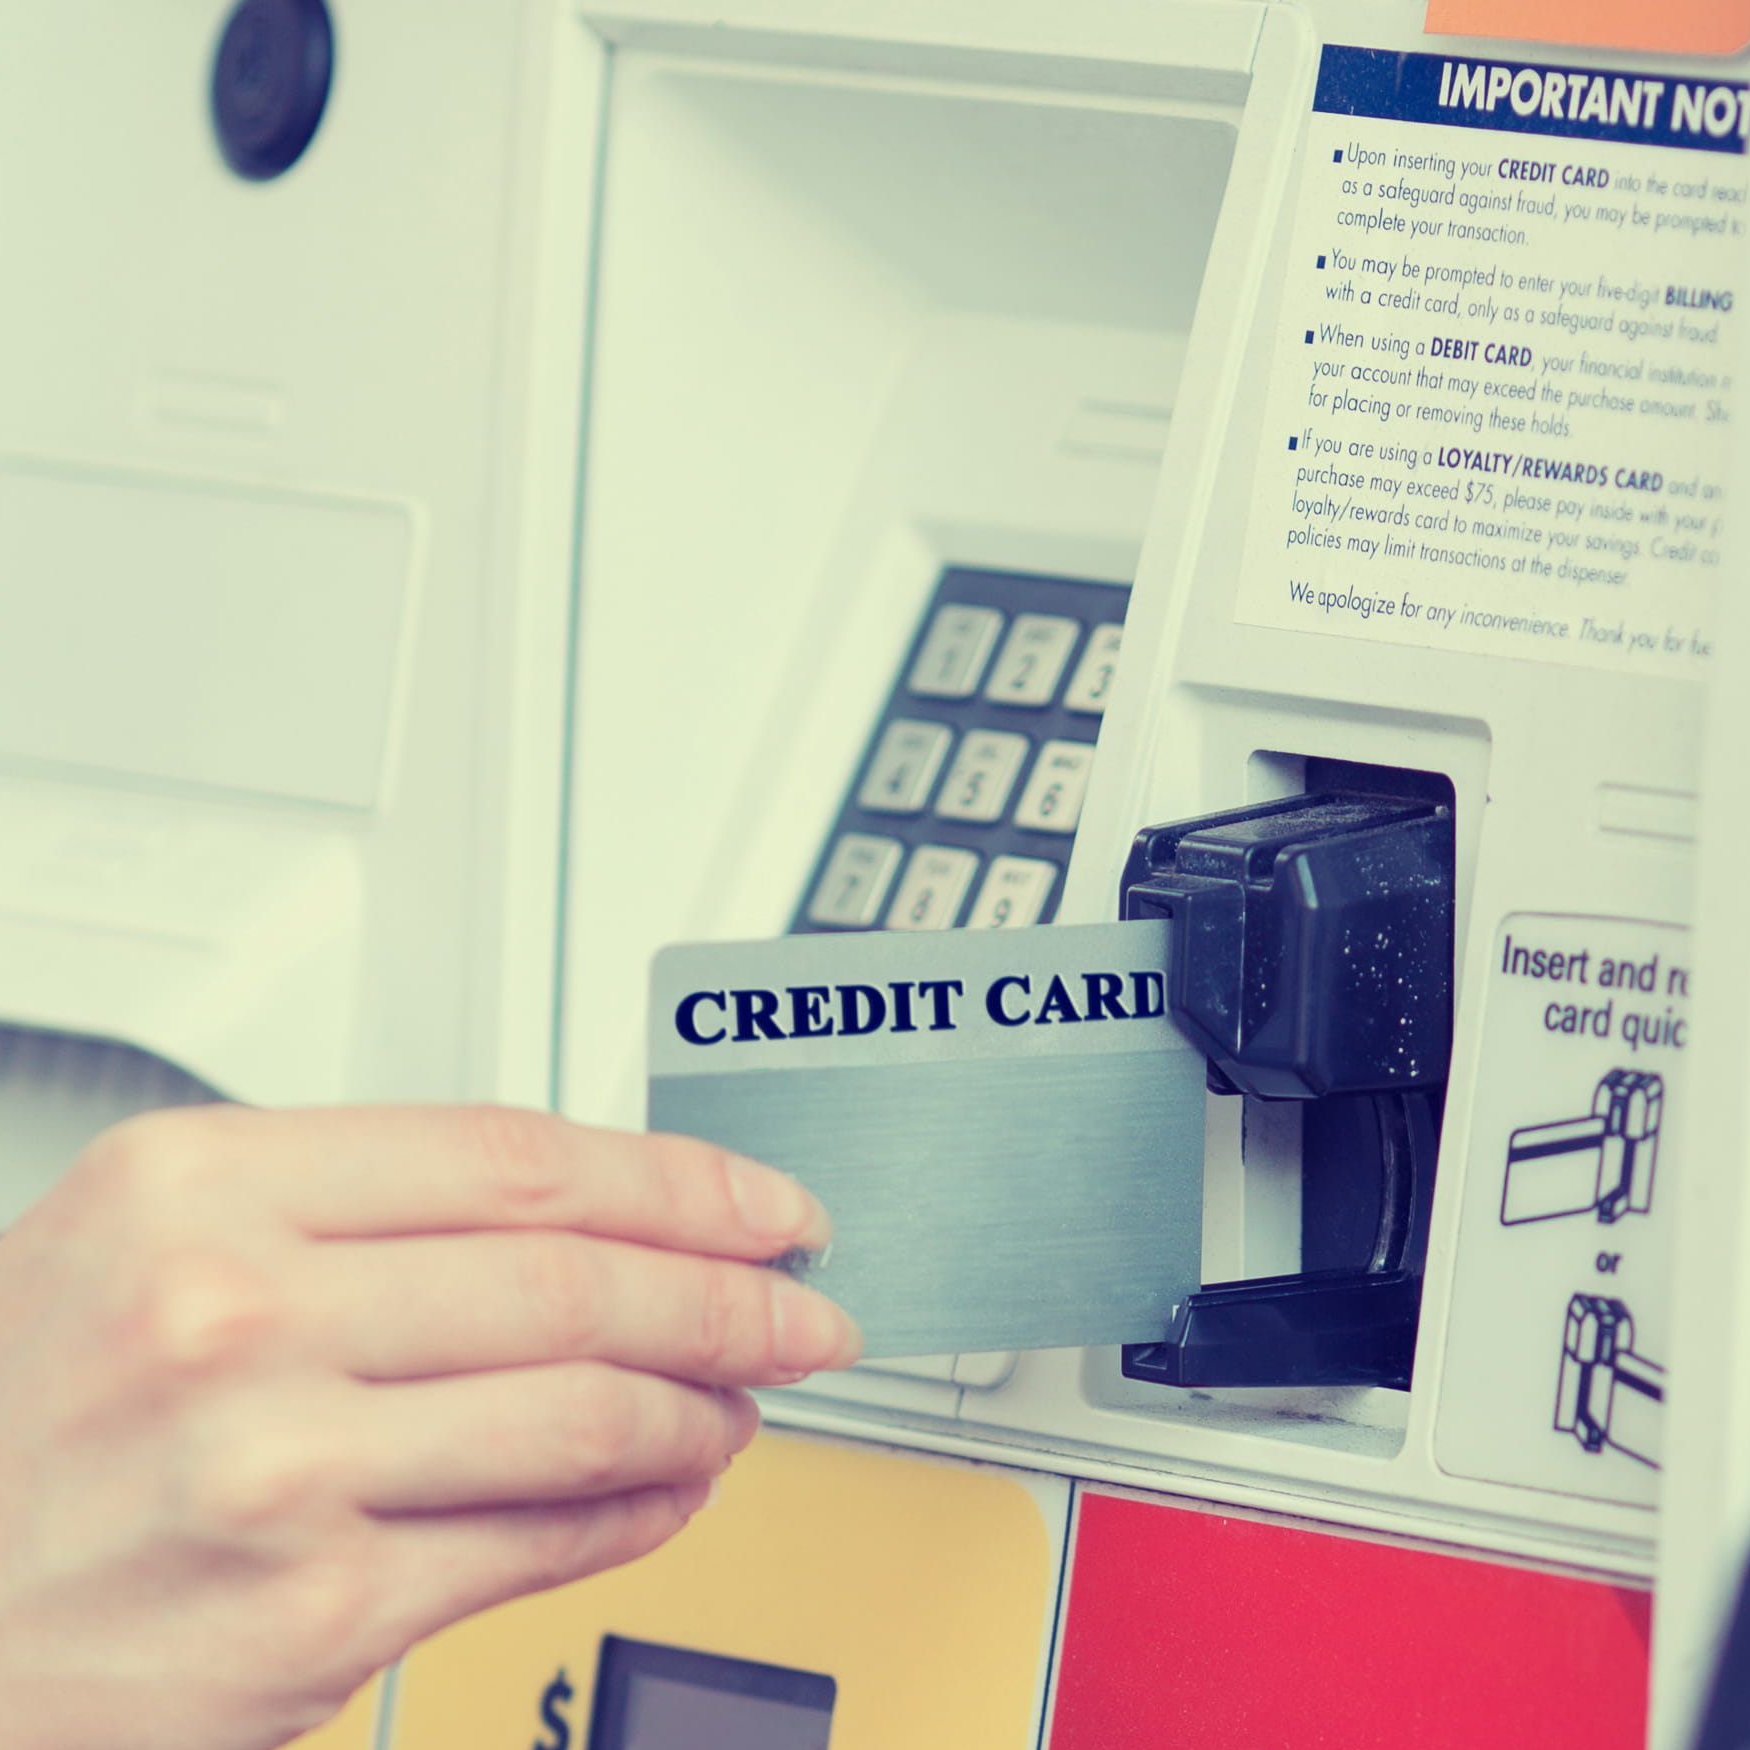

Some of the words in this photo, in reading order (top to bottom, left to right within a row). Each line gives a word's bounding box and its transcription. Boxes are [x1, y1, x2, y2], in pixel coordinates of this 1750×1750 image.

[1438, 61, 1664, 130] IMPORTANT
[1346, 140, 1387, 170] Upon
[1392, 147, 1456, 180] inserting
[1459, 160, 1493, 181] your
[1497, 157, 1557, 183] CREDIT
[1560, 163, 1610, 189] CARD
[1336, 207, 1406, 235] complete
[1409, 219, 1444, 240] your
[1446, 219, 1528, 245] transaction.
[1340, 179, 1358, 195] as
[1361, 181, 1373, 197] a
[1377, 176, 1456, 209] safeguard
[1457, 189, 1513, 215] against
[1515, 188, 1558, 220] fraud,
[1562, 203, 1591, 224] you
[1325, 280, 1355, 302] with
[1359, 289, 1372, 305] a
[1376, 287, 1421, 310] credit
[1423, 291, 1461, 319] card,
[1466, 295, 1499, 325] only
[1502, 305, 1520, 323] as
[1523, 307, 1535, 324] a
[1538, 302, 1615, 334] safeguard
[1331, 247, 1357, 271] You
[1360, 257, 1398, 282] may
[1400, 254, 1421, 279] be
[1422, 263, 1497, 290] prompted
[1498, 269, 1514, 289] to
[1517, 273, 1555, 293] enter
[1557, 280, 1593, 301] your
[1663, 284, 1733, 313] BILLING
[1319, 322, 1364, 348] When
[1370, 331, 1411, 360] using
[1414, 340, 1426, 356] a
[1429, 335, 1480, 361] DEBIT
[1539, 355, 1575, 375] your
[1577, 349, 1644, 381] financial
[1307, 382, 1329, 408] for
[1330, 387, 1391, 422] placing
[1394, 402, 1412, 418] or
[1414, 404, 1484, 433] removing
[1487, 405, 1526, 433] these
[1529, 409, 1572, 438] holds.
[1311, 360, 1346, 381] your
[1349, 365, 1412, 385] account
[1415, 367, 1444, 390] that
[1446, 376, 1480, 400] may
[1482, 379, 1538, 401] exceed
[1539, 380, 1563, 404] the
[1565, 386, 1635, 413] purchase
[1300, 426, 1313, 450] If
[1313, 437, 1343, 458] you
[1347, 441, 1374, 459] are
[1378, 441, 1418, 470] using
[1421, 450, 1433, 466] a
[1436, 445, 1609, 487] LOYALTY/REWARDS
[1613, 466, 1664, 493] CARD
[1291, 488, 1410, 527] loyalty/rewards
[1413, 508, 1450, 532] card
[1452, 514, 1468, 534] to
[1470, 519, 1543, 544] maximize
[1545, 529, 1581, 549] your
[1294, 462, 1365, 489] purchase
[1368, 475, 1403, 499] may
[1405, 478, 1461, 501] exceed
[1463, 478, 1496, 509] $75,
[1501, 485, 1552, 513] please
[1553, 498, 1585, 522] pay
[1588, 500, 1634, 523] inside
[1638, 504, 1669, 526] with
[1285, 522, 1342, 550] policies
[1345, 536, 1380, 560] may
[1382, 532, 1416, 558] limit
[1418, 541, 1506, 571] transactions
[1510, 555, 1527, 573] at
[1529, 552, 1553, 577] the
[1289, 579, 1315, 605] We
[1317, 583, 1396, 619] apologize
[1399, 590, 1423, 618] for
[1425, 604, 1457, 629] any
[1458, 602, 1569, 638] inconvenience.
[1578, 616, 1624, 645] Thank
[1011, 653, 1038, 691] 2
[1089, 663, 1114, 699] 3
[960, 771, 987, 808] 5
[1039, 783, 1064, 818] 6
[991, 896, 1014, 928] 9
[1502, 934, 1590, 985] Insert
[1598, 953, 1659, 993] and
[674, 980, 964, 1046] CREDIT
[985, 971, 1167, 1027] CARD
[1544, 999, 1614, 1038] card
[1595, 1252, 1622, 1274] or
